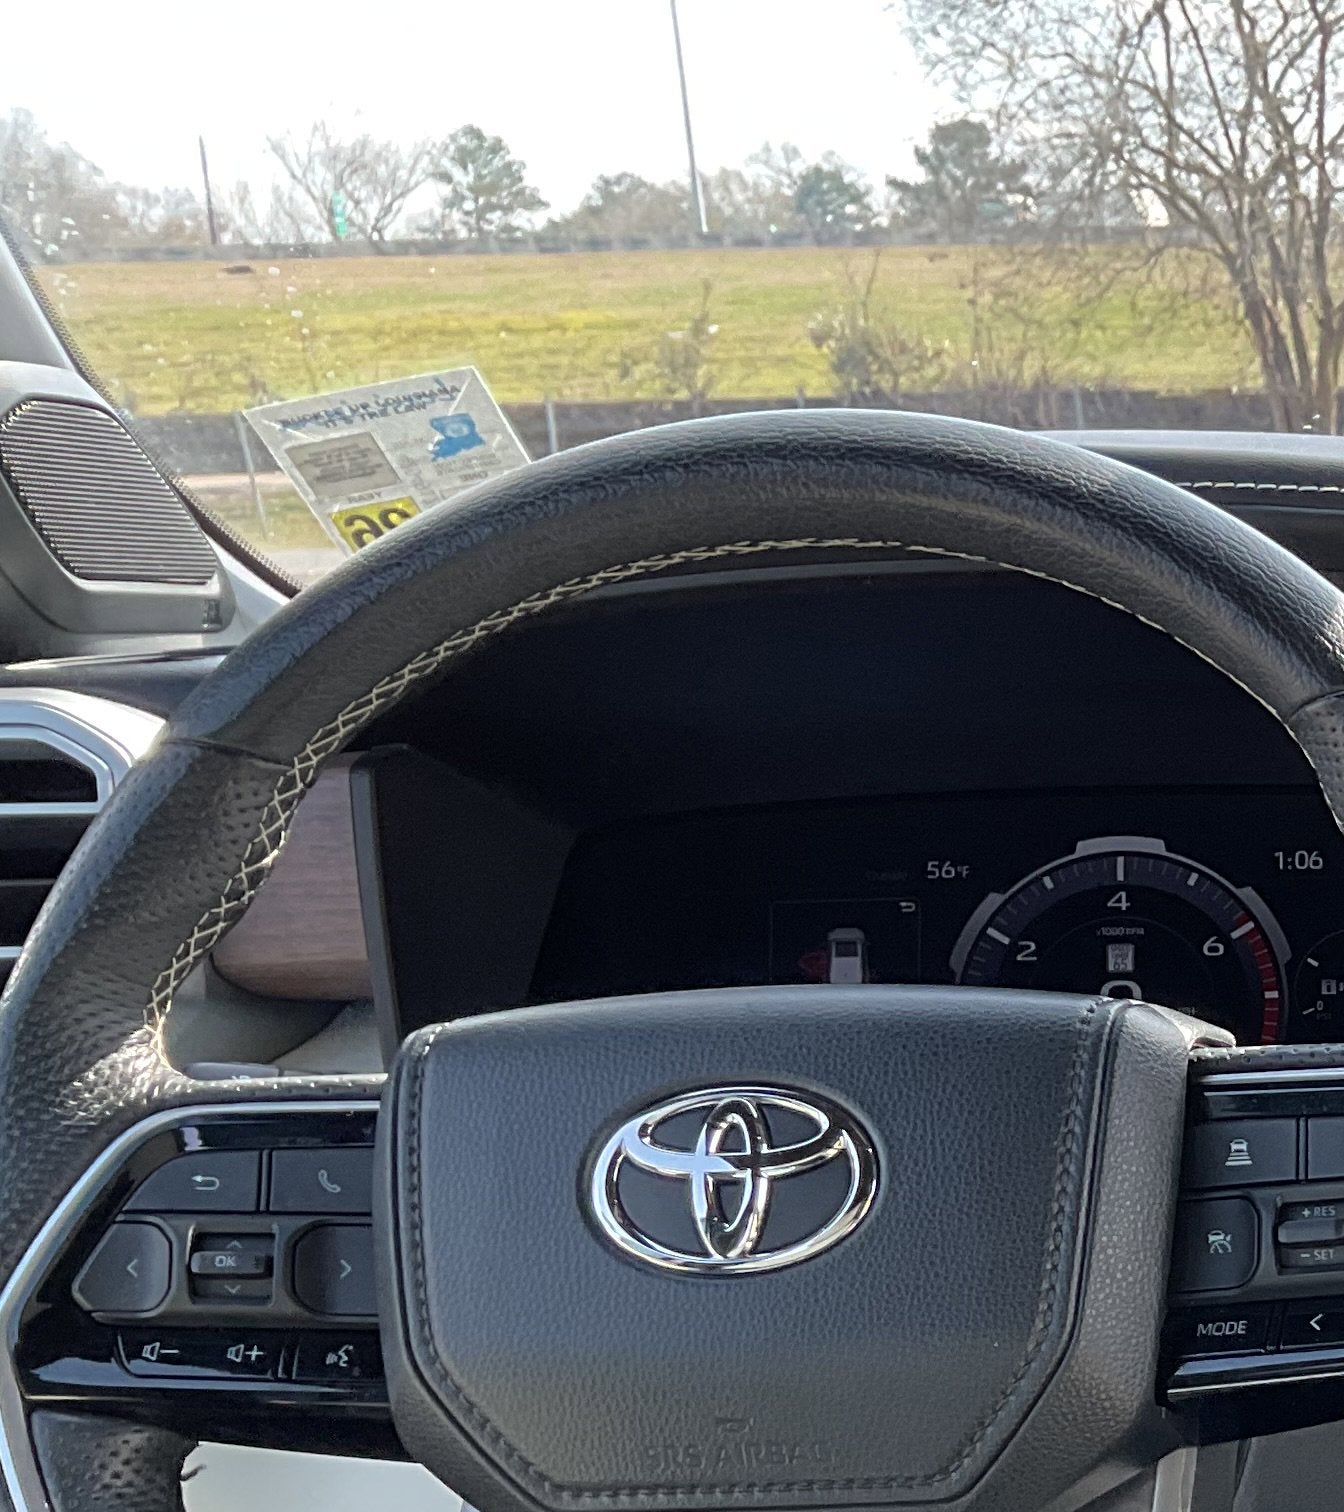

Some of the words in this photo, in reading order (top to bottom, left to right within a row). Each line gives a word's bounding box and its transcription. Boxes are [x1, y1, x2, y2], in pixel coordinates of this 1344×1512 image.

[1274, 850, 1324, 871] 1:06
[1107, 890, 1131, 911] 4
[1015, 940, 1038, 961] 2
[1202, 936, 1225, 956] 6
[1316, 1001, 1324, 1011] 0
[1313, 1206, 1336, 1217] RES
[214, 1255, 237, 1268] OK
[1313, 1250, 1335, 1261] SET
[1196, 1320, 1249, 1337] MODE
